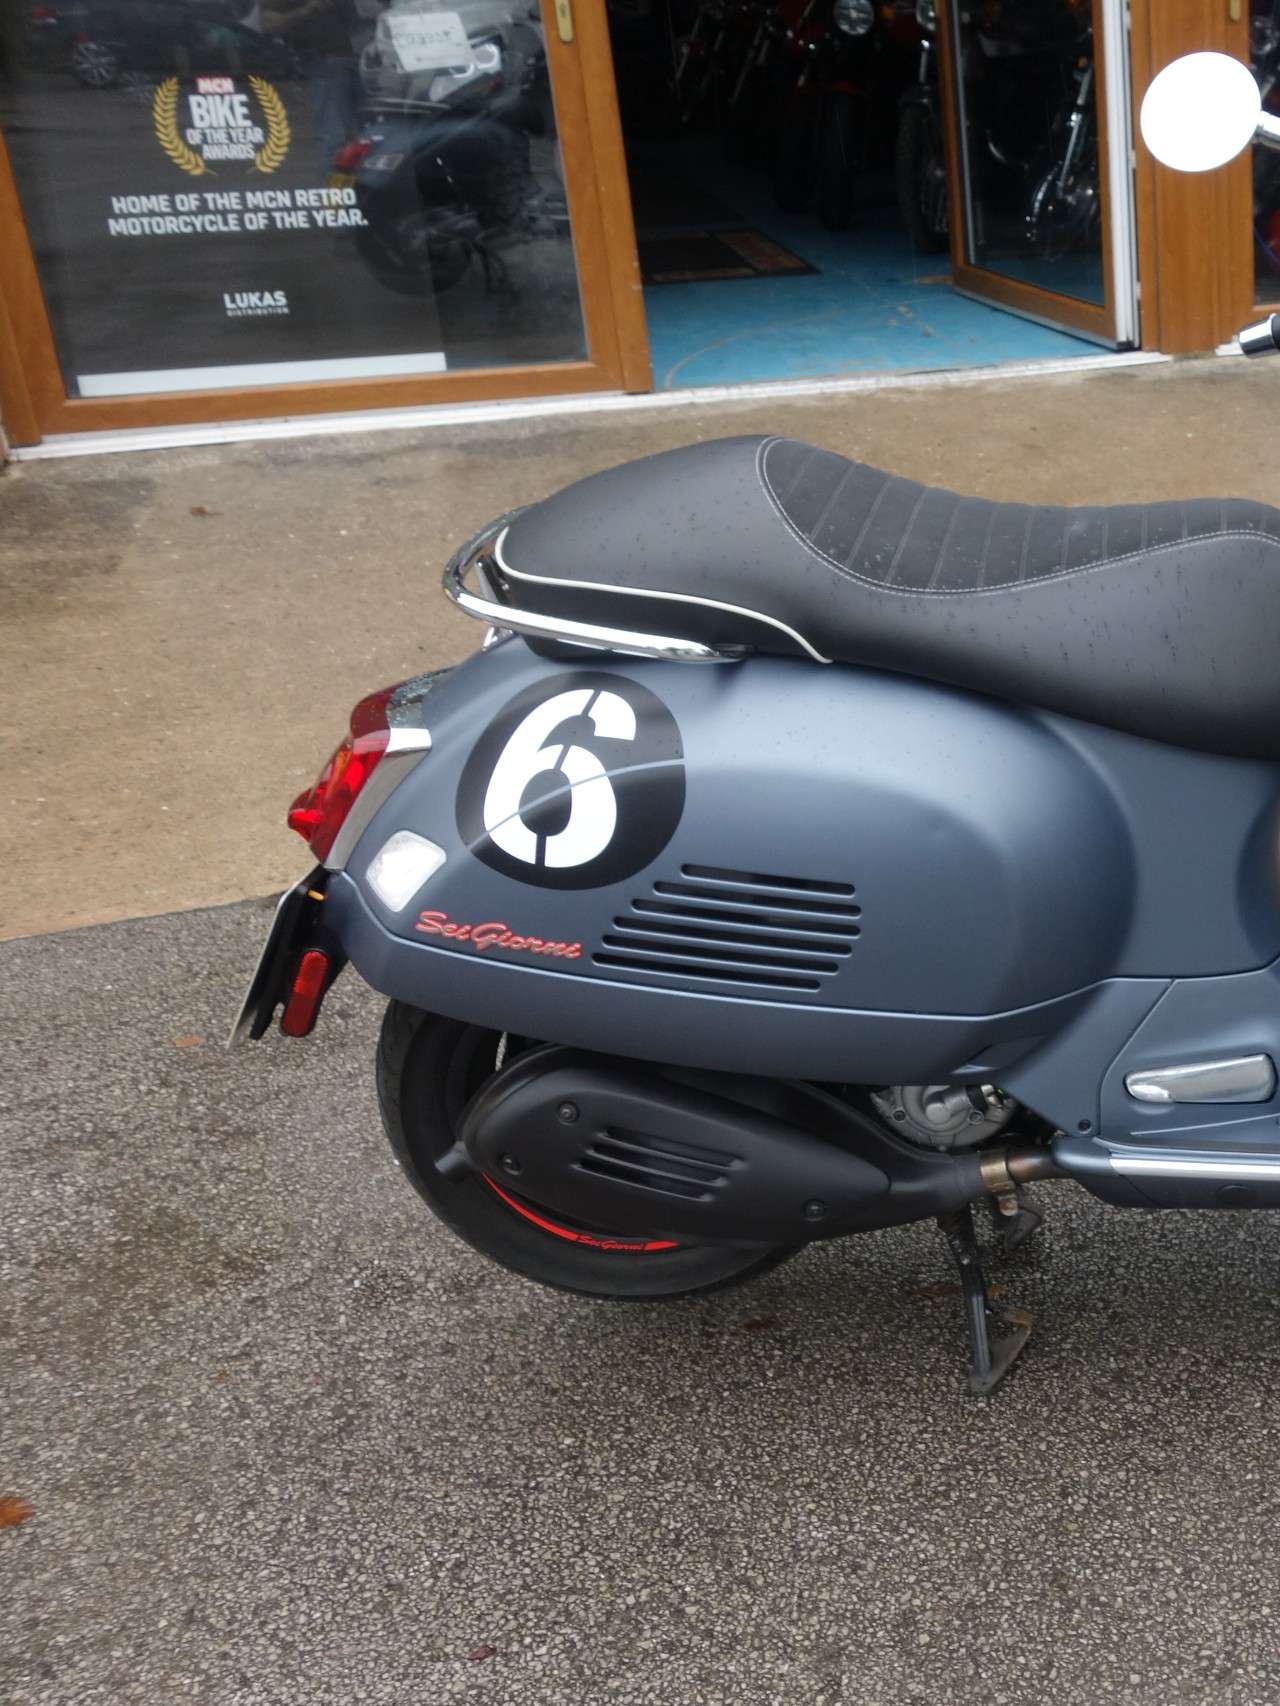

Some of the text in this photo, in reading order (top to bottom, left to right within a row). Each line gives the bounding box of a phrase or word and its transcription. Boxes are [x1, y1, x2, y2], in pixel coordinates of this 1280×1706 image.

[196, 77, 235, 94] MCN
[188, 93, 253, 128] BIKE
[185, 126, 265, 145] OF THE YEAR
[202, 143, 256, 160] AWARDS
[111, 187, 357, 214] HOME OF THE MCN RETRO
[107, 208, 369, 236] MOTORCYCLE OF THE YEAR.
[223, 290, 288, 309] LUKAS
[484, 689, 636, 868] 6
